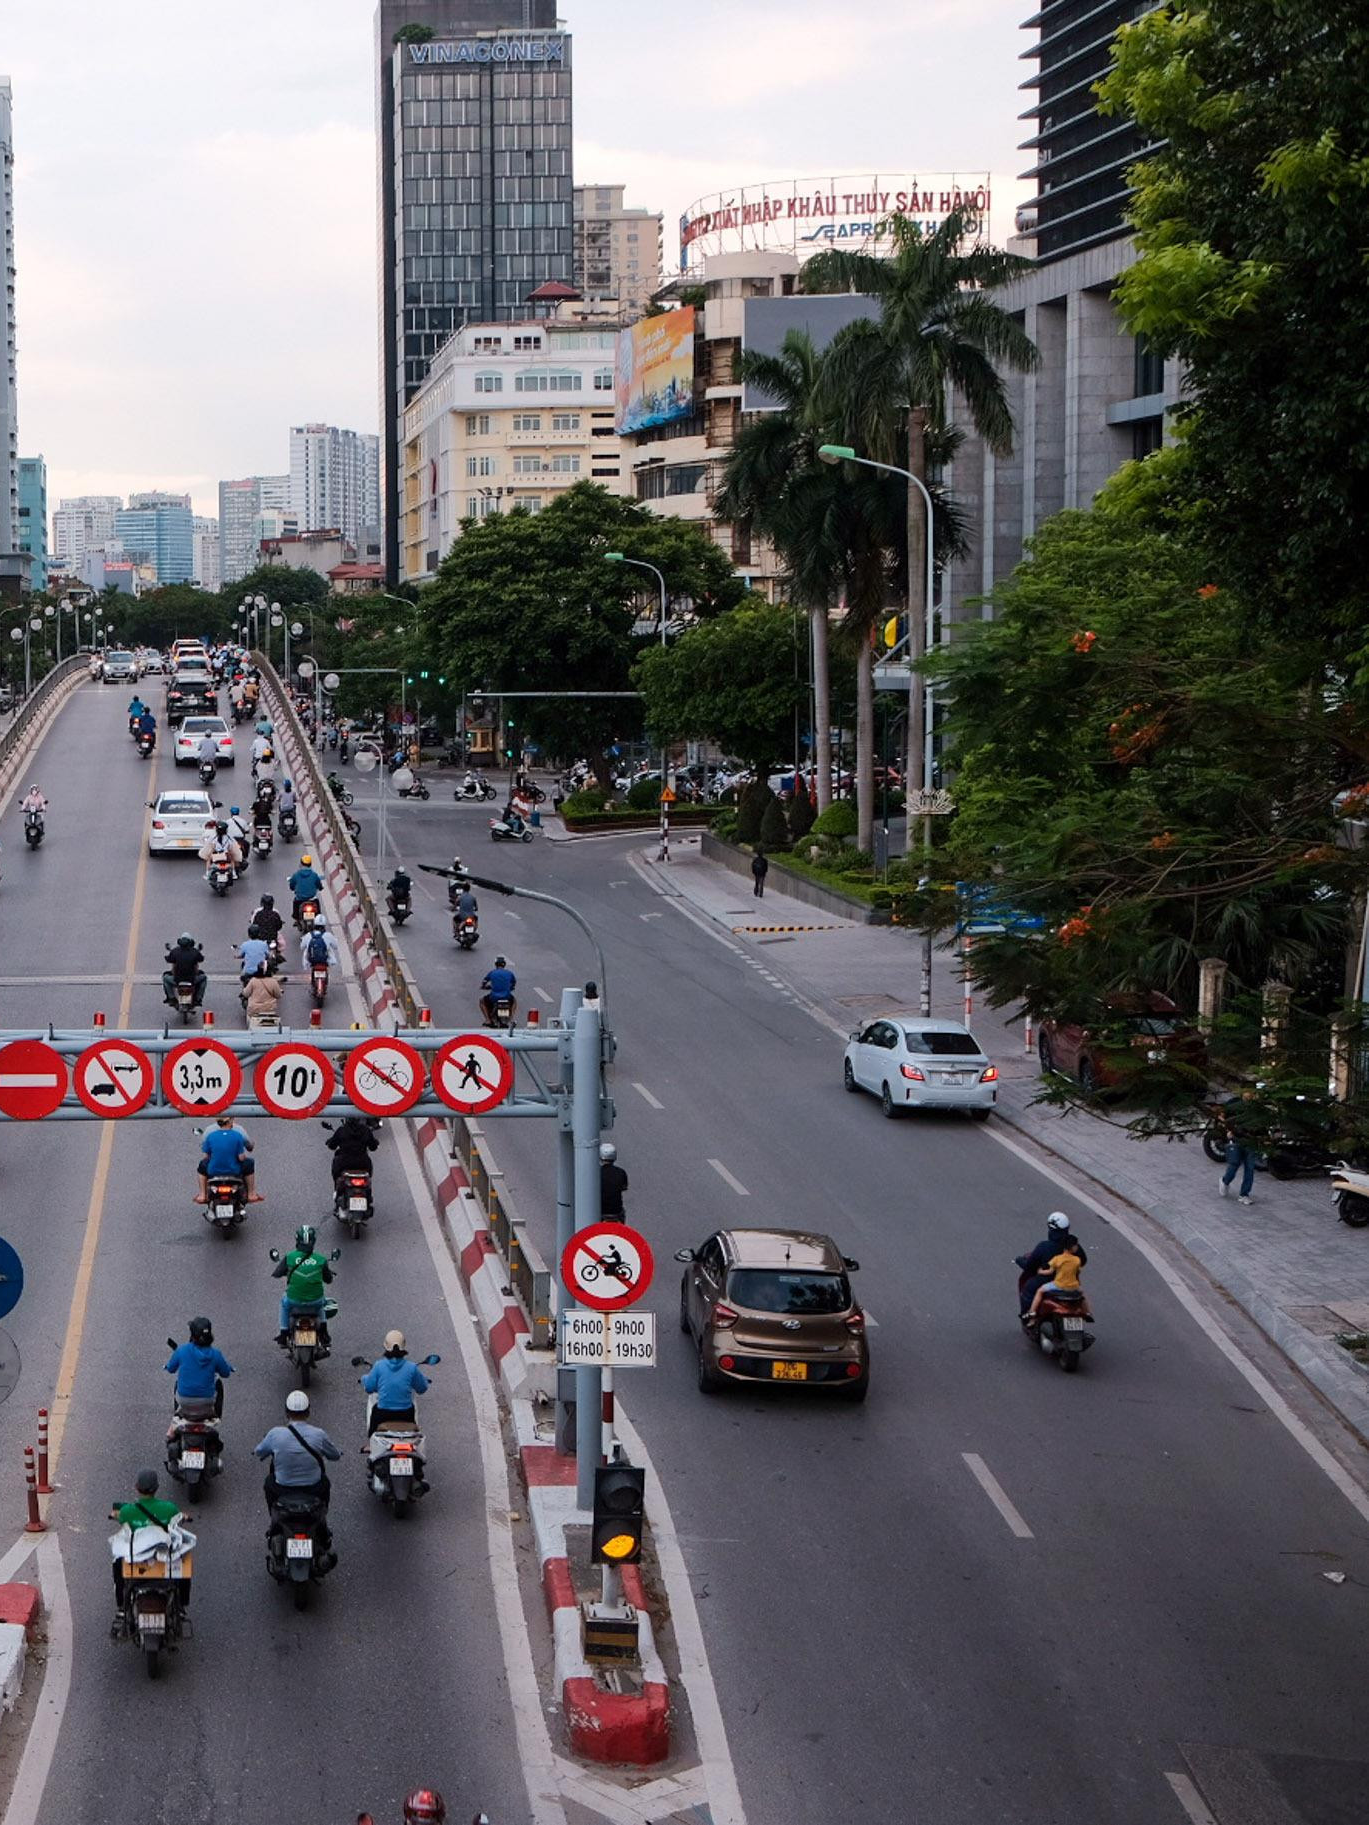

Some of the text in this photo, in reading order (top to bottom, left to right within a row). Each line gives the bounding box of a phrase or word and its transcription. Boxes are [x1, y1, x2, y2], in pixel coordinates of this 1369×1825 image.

[409, 41, 563, 63] VINACONEX
[573, 1319, 603, 1334] 6h00
[614, 1320, 645, 1336] 9h00
[567, 1341, 603, 1357] 16h00
[616, 1342, 652, 1358] 19h30
